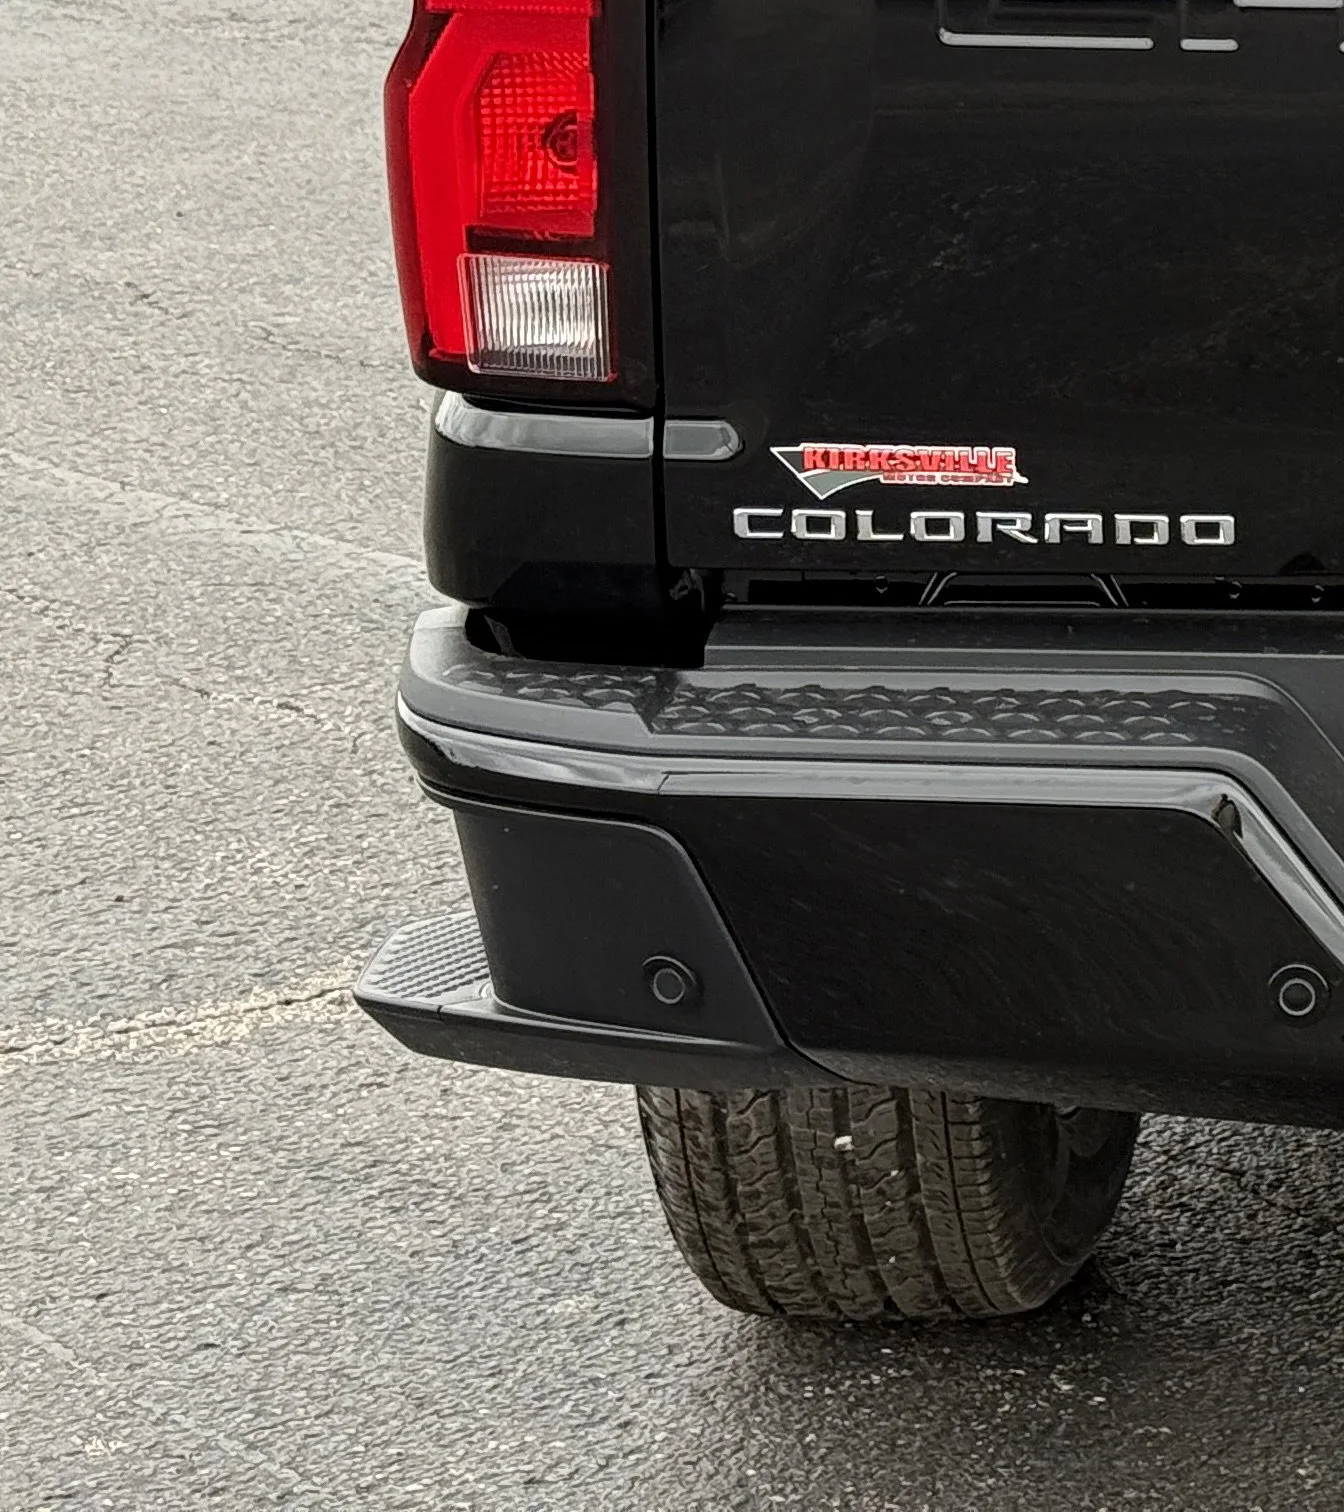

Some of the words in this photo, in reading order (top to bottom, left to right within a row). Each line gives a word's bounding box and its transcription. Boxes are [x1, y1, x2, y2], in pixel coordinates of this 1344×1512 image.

[802, 446, 1014, 473] KIRKSVILLE
[883, 473, 936, 482] MOTOR
[732, 506, 1236, 546] COLORADO
